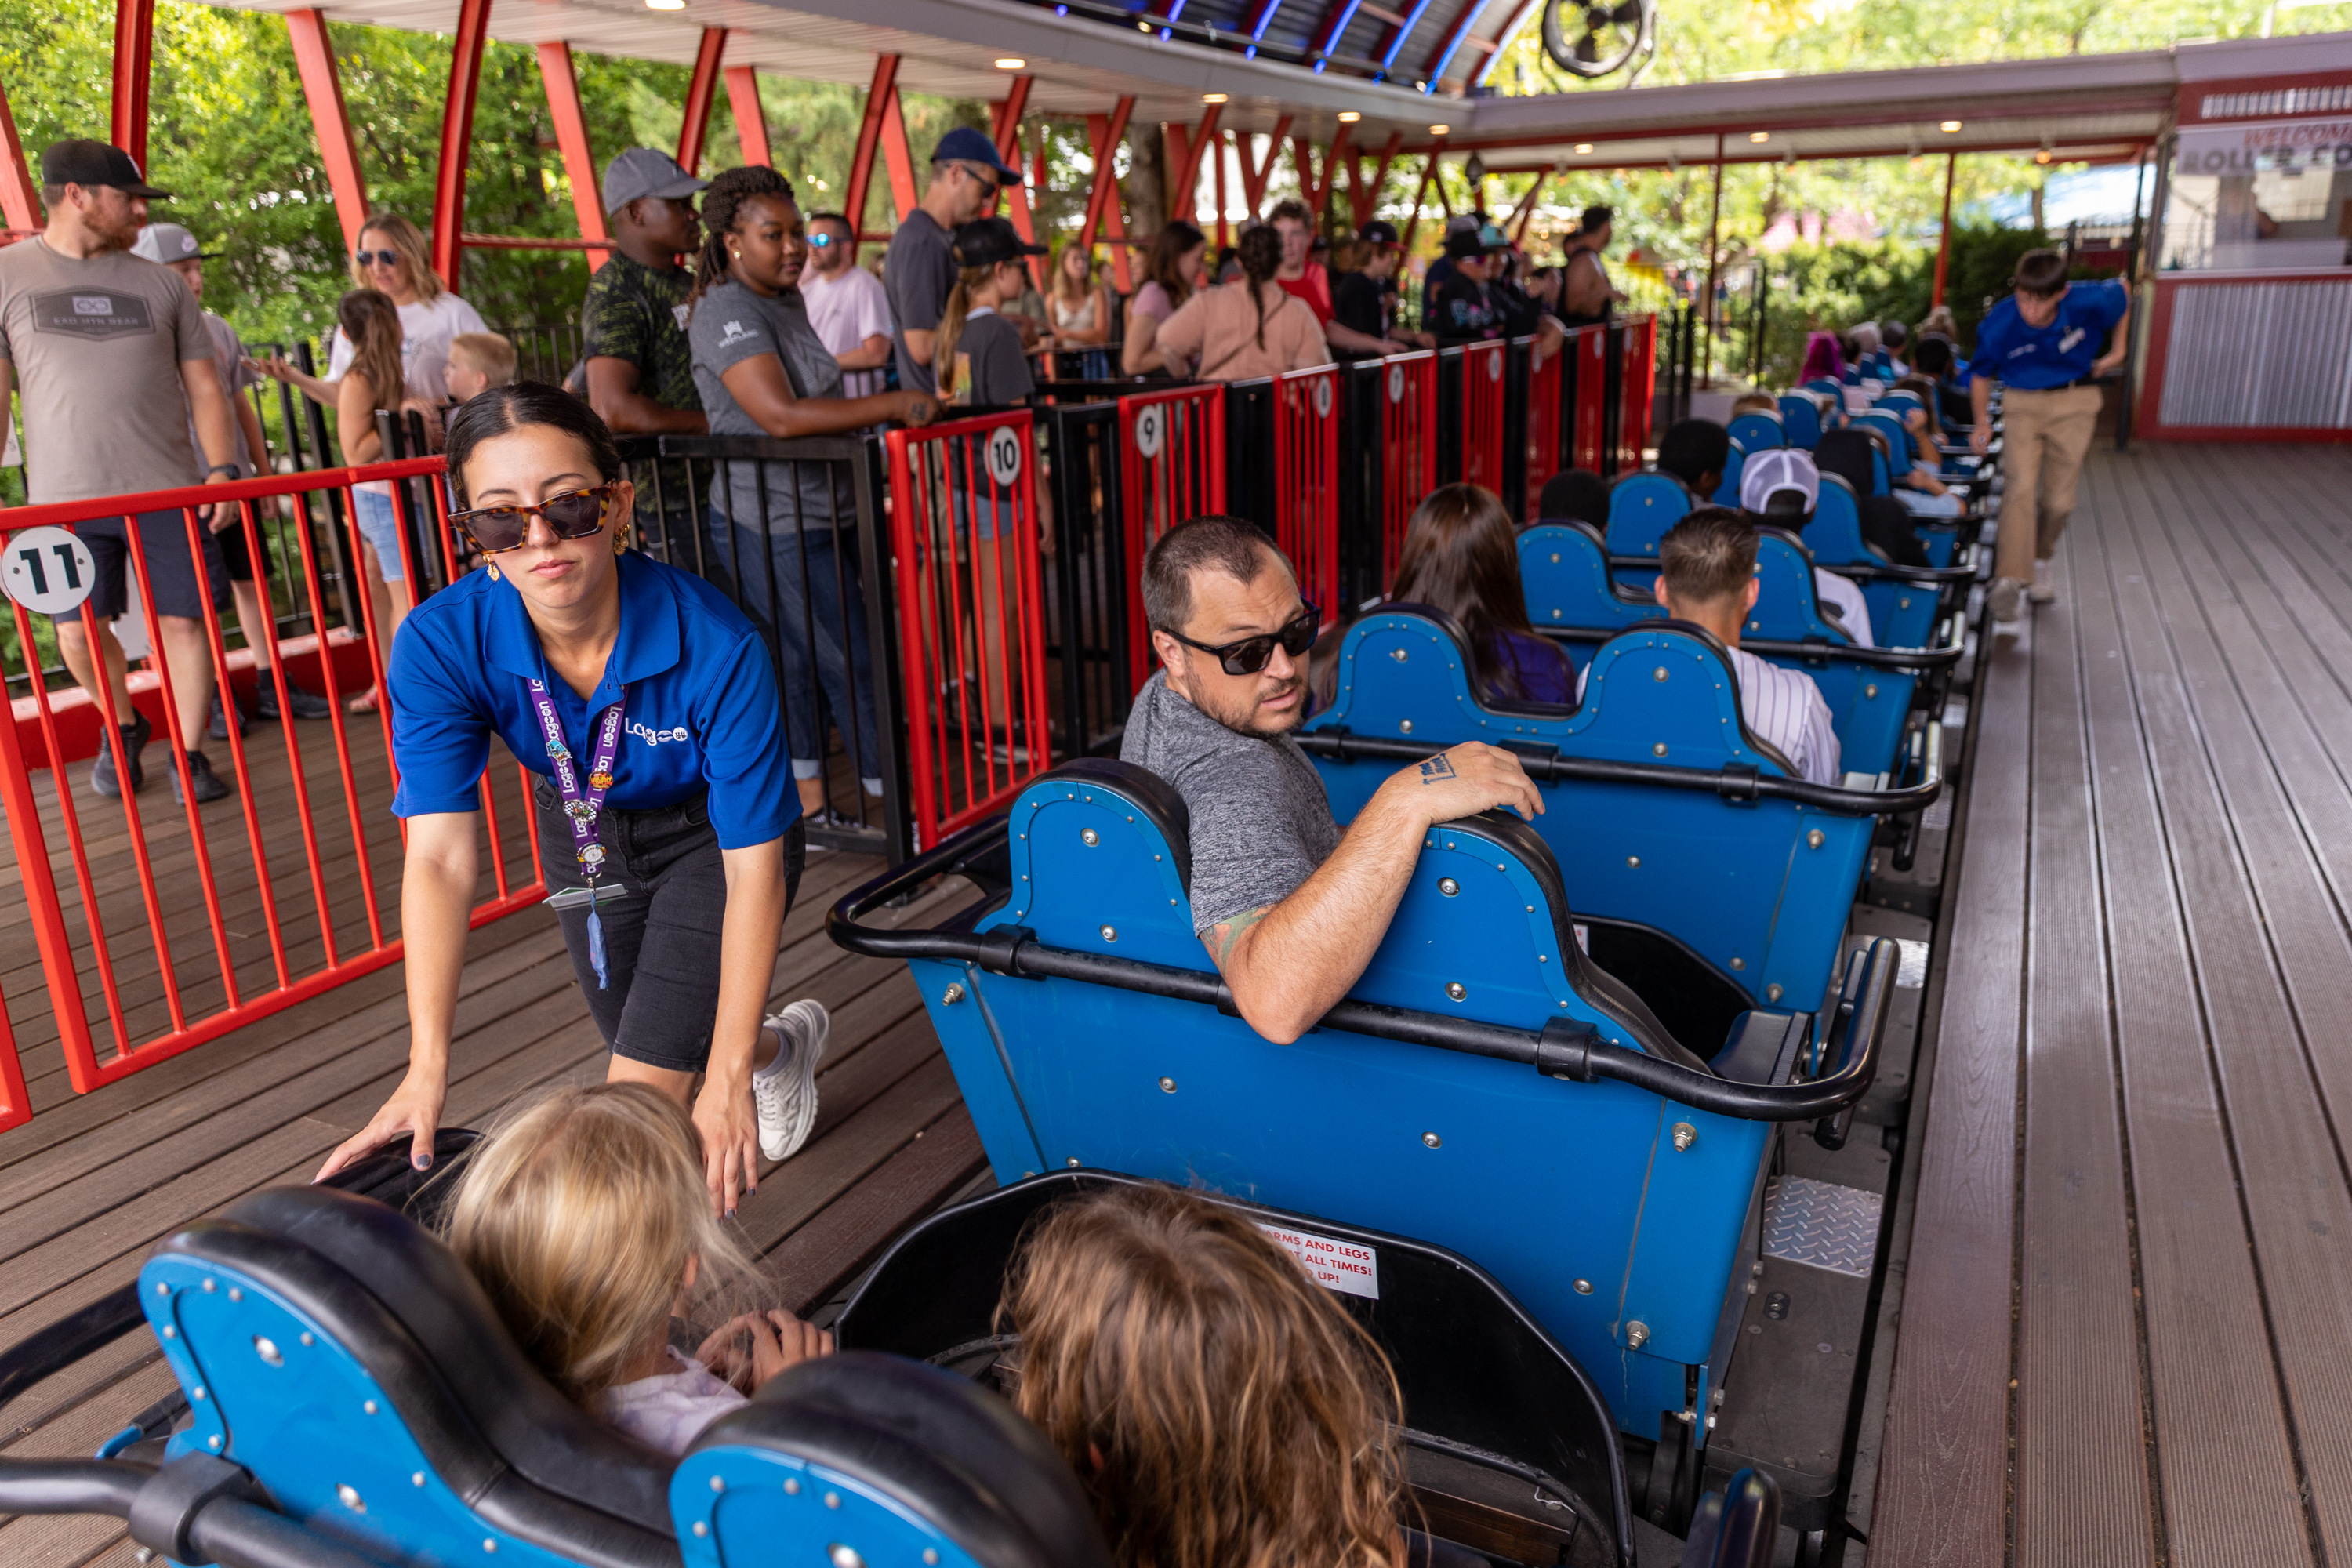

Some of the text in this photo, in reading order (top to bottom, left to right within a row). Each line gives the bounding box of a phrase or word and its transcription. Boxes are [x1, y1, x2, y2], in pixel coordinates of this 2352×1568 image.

[1144, 416, 1155, 445] 9
[994, 440, 1016, 473] 10
[19, 543, 82, 595] 11
[539, 701, 560, 741] agoon
[603, 706, 622, 747] Lagoon
[625, 717, 688, 746] Lagoo
[557, 759, 575, 793] Lagoo
[1305, 1240, 1334, 1252] AND
[1339, 1247, 1370, 1261] LEGS
[1305, 1254, 1327, 1266] ALL
[1330, 1259, 1372, 1276] TIMES!
[1318, 1271, 1339, 1283] UP!
